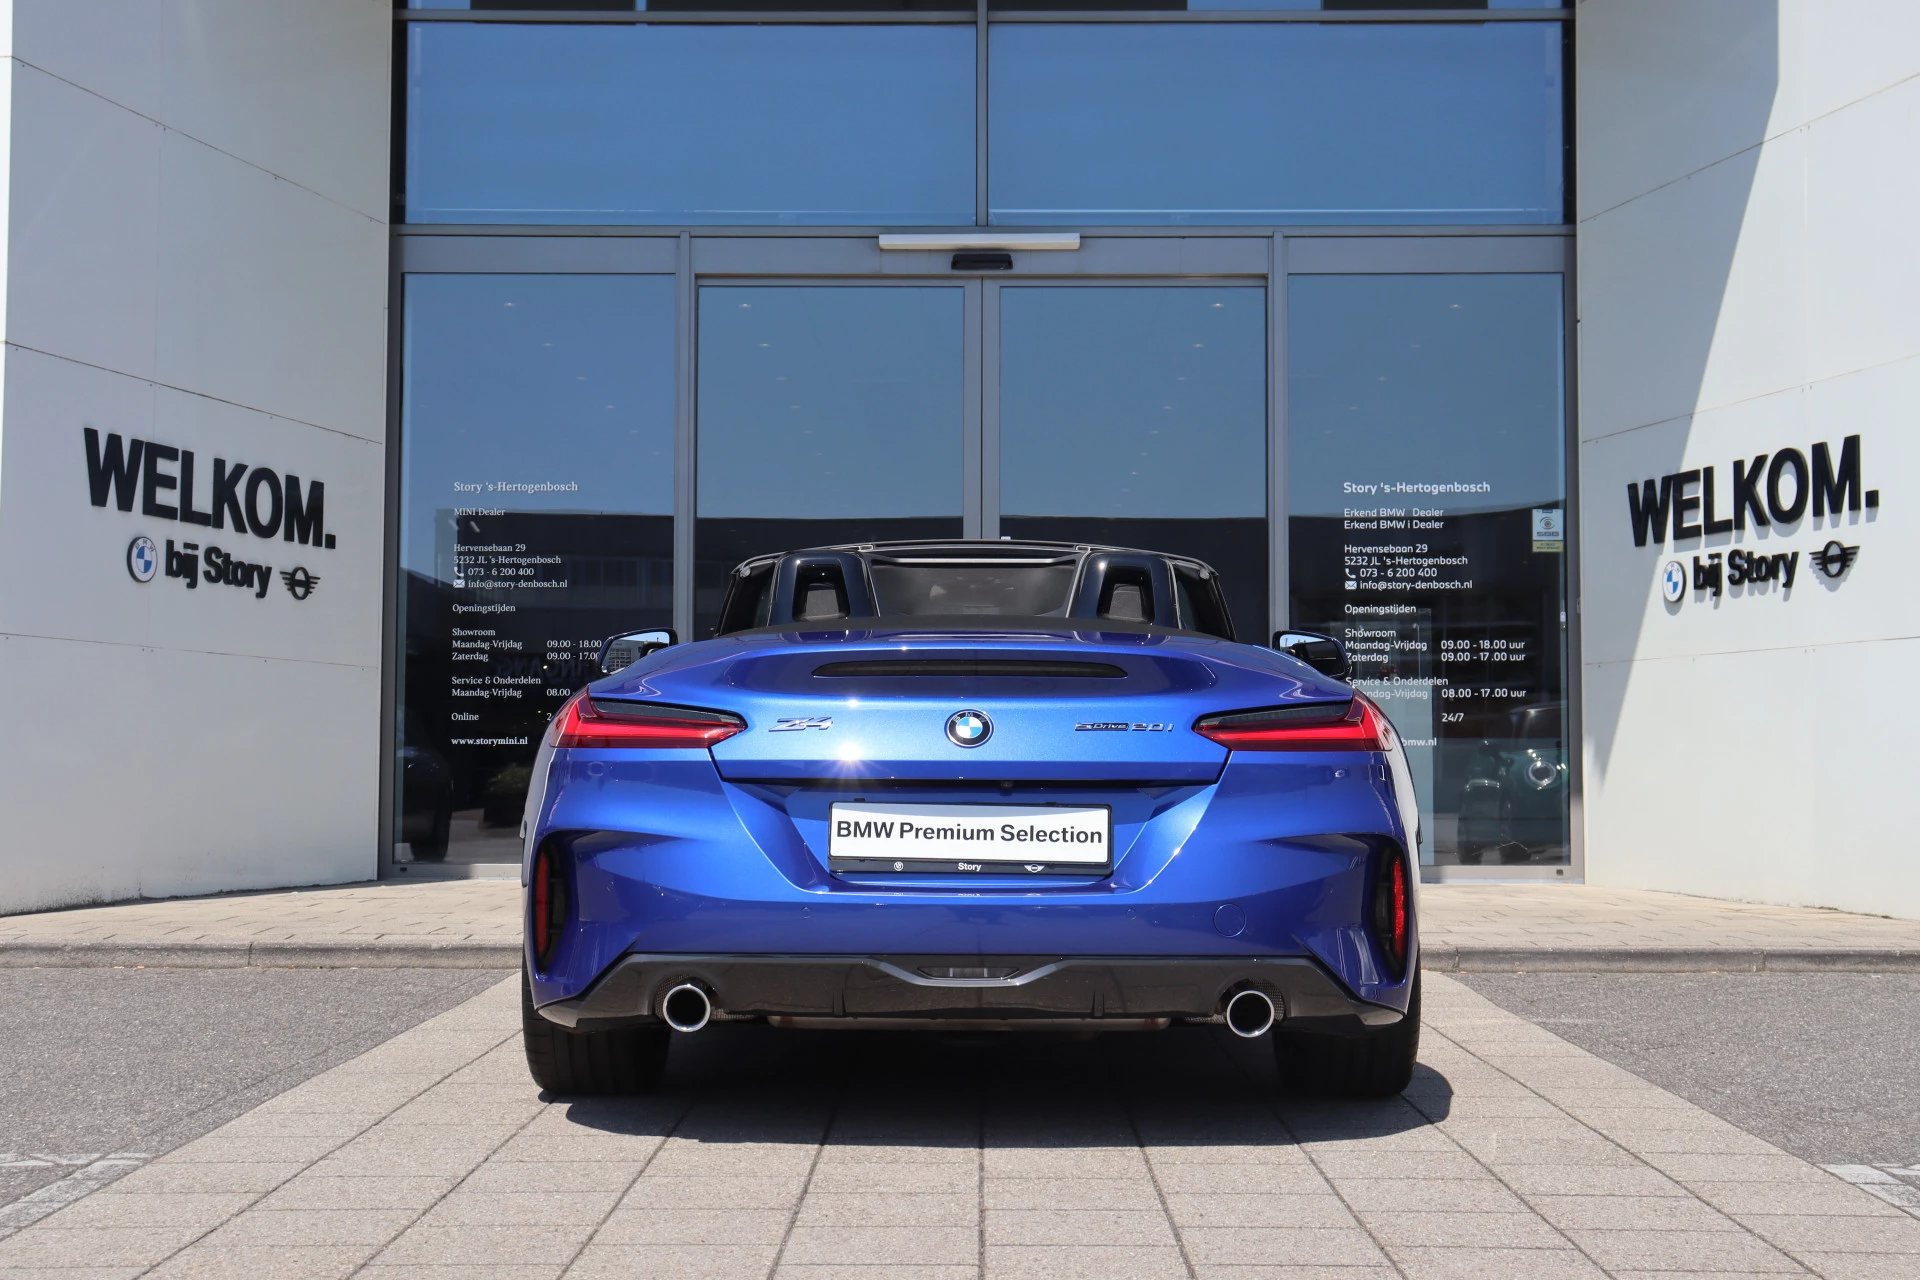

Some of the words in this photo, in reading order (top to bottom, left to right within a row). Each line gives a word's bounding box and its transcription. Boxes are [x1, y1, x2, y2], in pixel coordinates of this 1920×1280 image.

[83, 427, 336, 549] WELKOM.
[454, 482, 482, 493] Story
[486, 482, 578, 493] 's-Hertogenbosch
[1344, 482, 1377, 495] Story
[1380, 482, 1490, 494] 's-Hertogenbosch
[1627, 434, 1879, 547] WELKOM.
[478, 508, 505, 516] Dealer
[1344, 508, 1377, 517] Erkend
[1380, 509, 1405, 517] BMW
[1413, 509, 1443, 517] Dealer
[1344, 521, 1377, 529] Erkend
[1380, 521, 1405, 529] BMW
[1407, 521, 1410, 529] i
[1413, 521, 1444, 529] Dealer
[1344, 545, 1413, 553] Hervensebaan
[1416, 544, 1428, 553] 29
[454, 556, 475, 564] 5232
[476, 556, 487, 564] JL
[489, 556, 561, 566] 's-Hertogenbosch
[1344, 557, 1368, 565] 5232
[1370, 557, 1381, 566] JL
[1383, 556, 1468, 567] 's-Hertogenbosch
[165, 540, 199, 589] bij
[203, 546, 272, 599] Story
[468, 568, 484, 576] 073
[1360, 569, 1378, 577] 073
[1387, 569, 1393, 577] 6
[1396, 568, 1415, 577] 200
[1418, 568, 1437, 577] 400
[1693, 553, 1722, 597] bij
[1728, 549, 1799, 588] Story
[468, 580, 568, 589] info@story-denbosch.nl
[1360, 580, 1473, 591] info@story-denbosch.nl
[452, 604, 516, 614] Openingstijden
[1345, 604, 1416, 615] Openingstijden
[452, 628, 496, 636] Showroom
[1345, 629, 1396, 638] Showroom
[452, 640, 523, 650] Maandag-Vrijdag
[547, 640, 571, 648] 09.00
[579, 640, 601, 648] 18.00
[1345, 641, 1427, 651] Maandag-Vrijdag
[1441, 641, 1470, 649] 09.00
[1479, 640, 1506, 649] 18.00
[452, 652, 488, 662] Zaterdag
[547, 652, 571, 660] 09.00
[1441, 653, 1470, 661] 09.00
[1479, 653, 1507, 661] 17.00
[452, 677, 482, 685] Service
[485, 677, 491, 685] &
[493, 676, 541, 685] Onderdelen
[1345, 677, 1380, 687] Service
[1383, 678, 1391, 686] &
[1393, 677, 1448, 686] Onderdelen
[452, 688, 522, 698] Maandag-Vrijdag
[1362, 689, 1428, 700] ndag-Vrijdag
[1441, 689, 1471, 698] 08.00
[1481, 689, 1507, 697] 17.00
[451, 713, 479, 721] Online
[1442, 713, 1464, 722] 24/7
[768, 716, 833, 732] Z4
[451, 737, 528, 745] www.storymini.nl
[836, 820, 895, 839] BMW
[899, 822, 995, 842] Premium
[1000, 824, 1102, 844] Selection
[958, 862, 982, 872] Story
